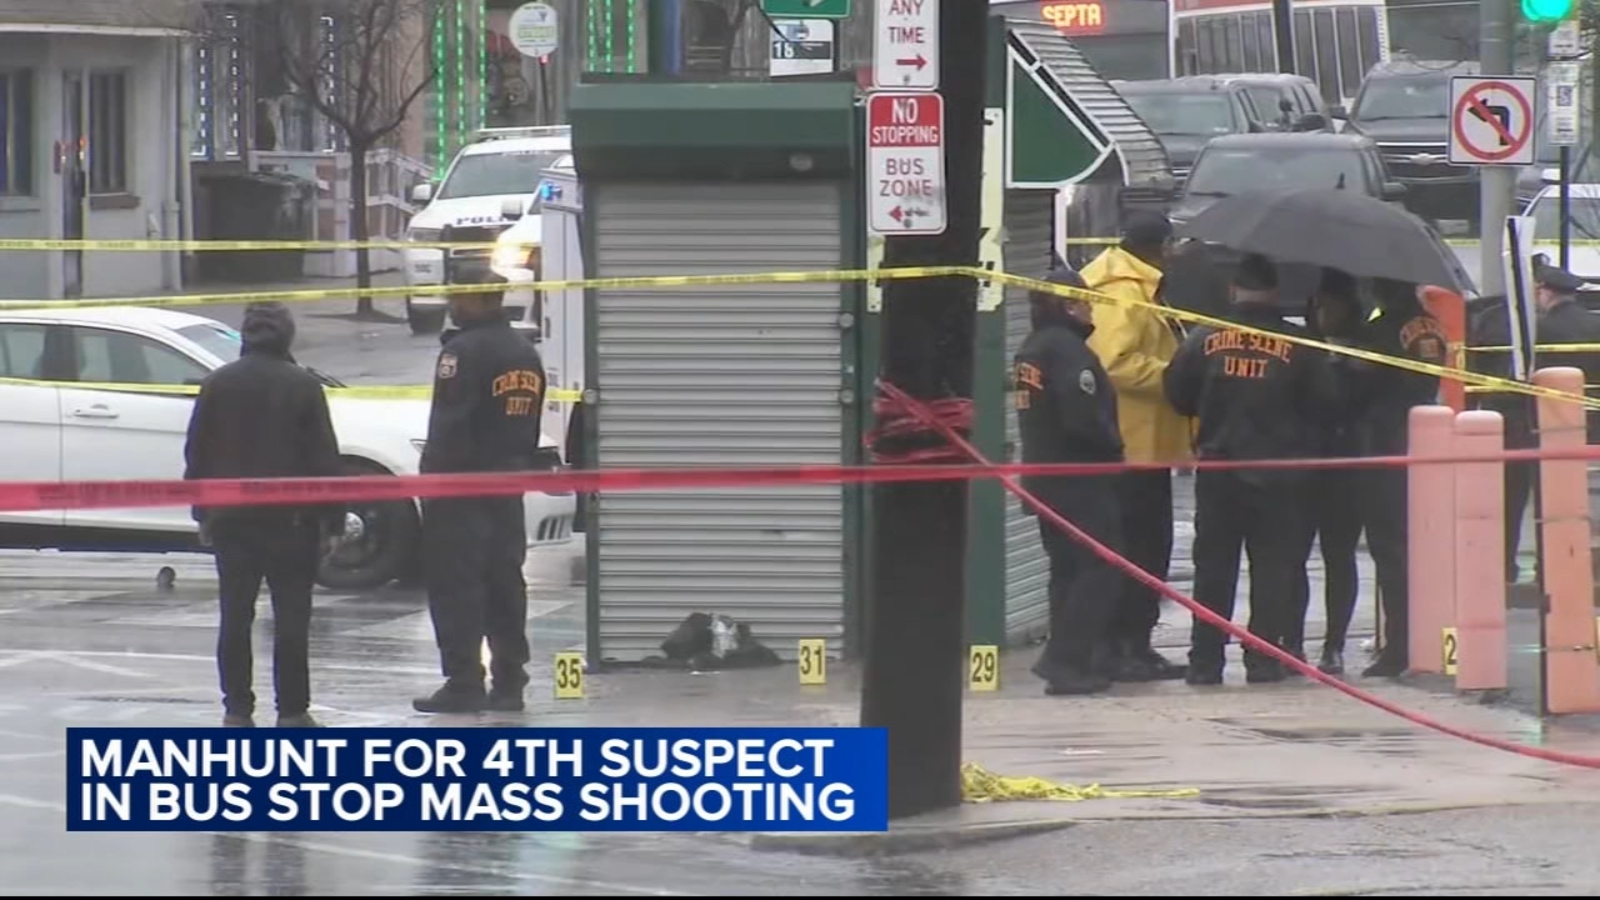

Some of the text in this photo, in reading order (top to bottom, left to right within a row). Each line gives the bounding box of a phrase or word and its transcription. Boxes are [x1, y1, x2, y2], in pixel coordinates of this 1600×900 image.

[889, 0, 923, 15] ANY
[1043, 4, 1100, 26] SEPTA
[889, 27, 925, 43] TIME
[892, 99, 918, 123] NO
[872, 126, 938, 143] STOPPING
[886, 159, 924, 175] BUS
[880, 180, 932, 197] ZONE
[1205, 330, 1293, 363] CRIME SCENE
[1225, 355, 1267, 377] UNIT
[800, 645, 822, 675] 31
[1445, 634, 1457, 665] 2
[557, 658, 580, 689] 35
[972, 652, 995, 682] 29
